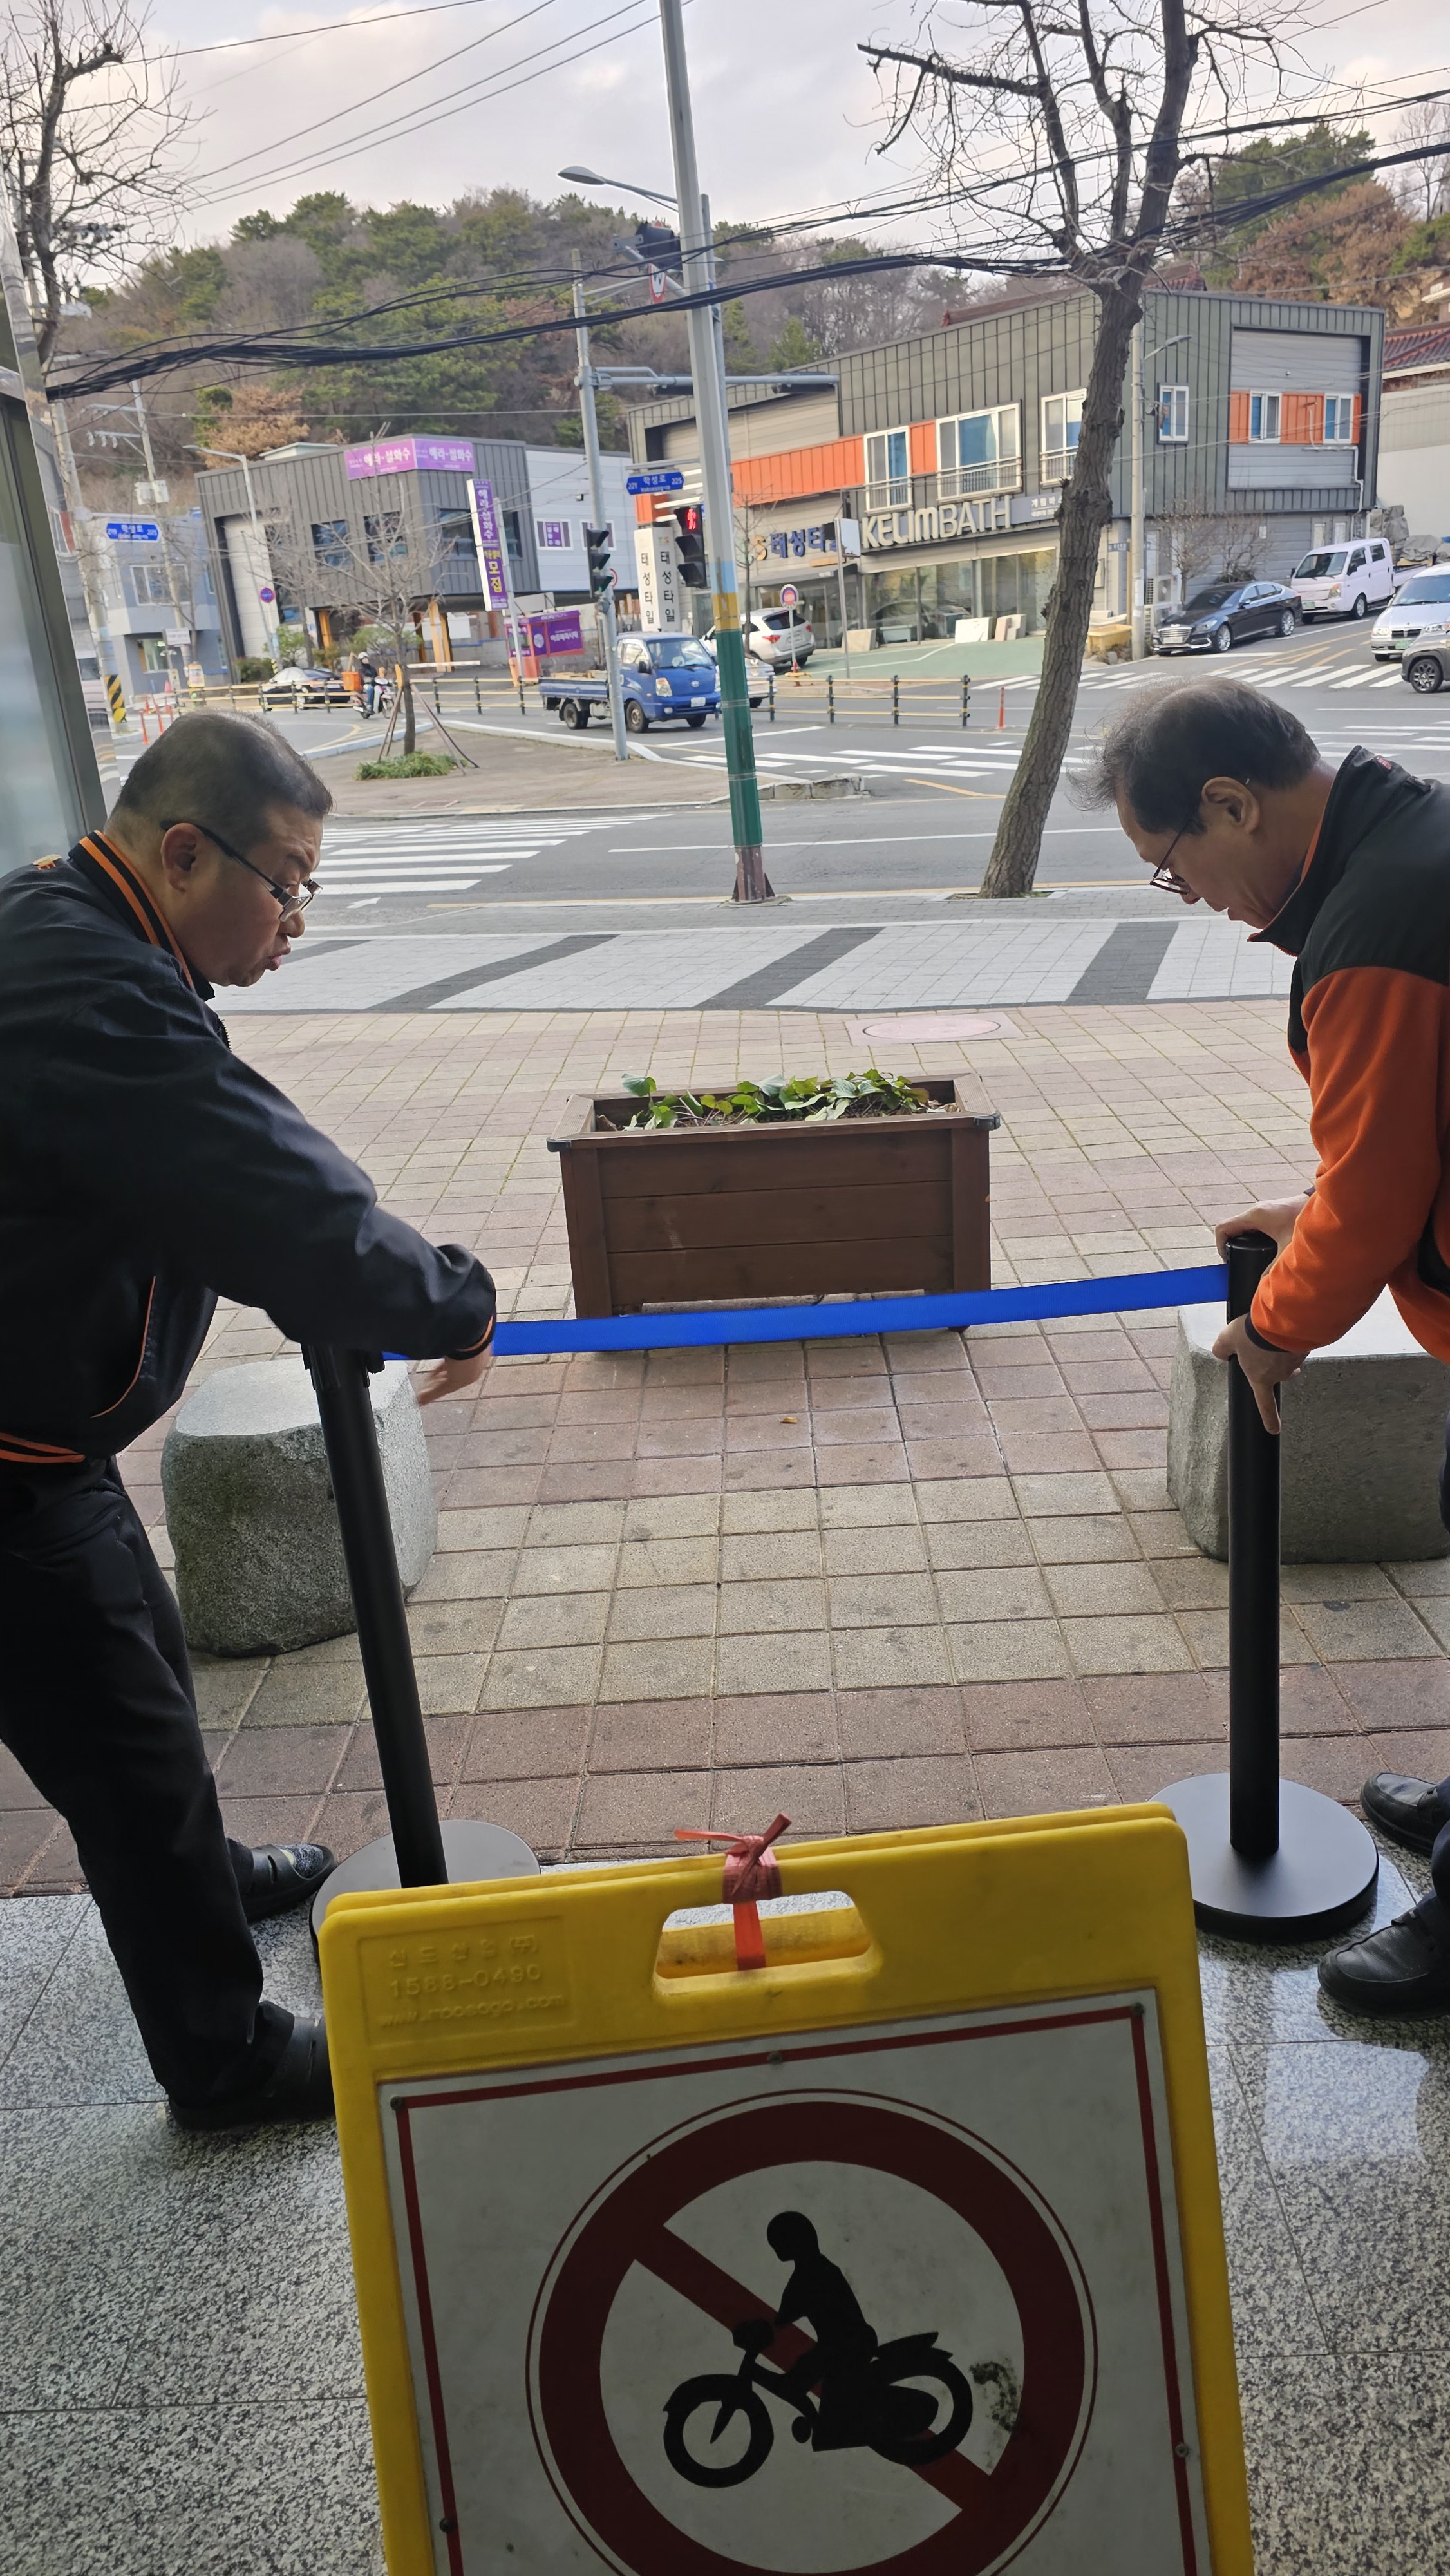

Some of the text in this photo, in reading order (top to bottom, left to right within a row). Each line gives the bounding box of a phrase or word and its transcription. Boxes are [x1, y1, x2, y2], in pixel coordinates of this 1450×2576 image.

[771, 526, 837, 558] 태성타
[861, 495, 1011, 549] KELIMBATH
[488, 561, 502, 593] 모집
[641, 553, 654, 624] 태성타일
[660, 551, 675, 623] 태성타일
[390, 1963, 542, 1998] 1588-0490
